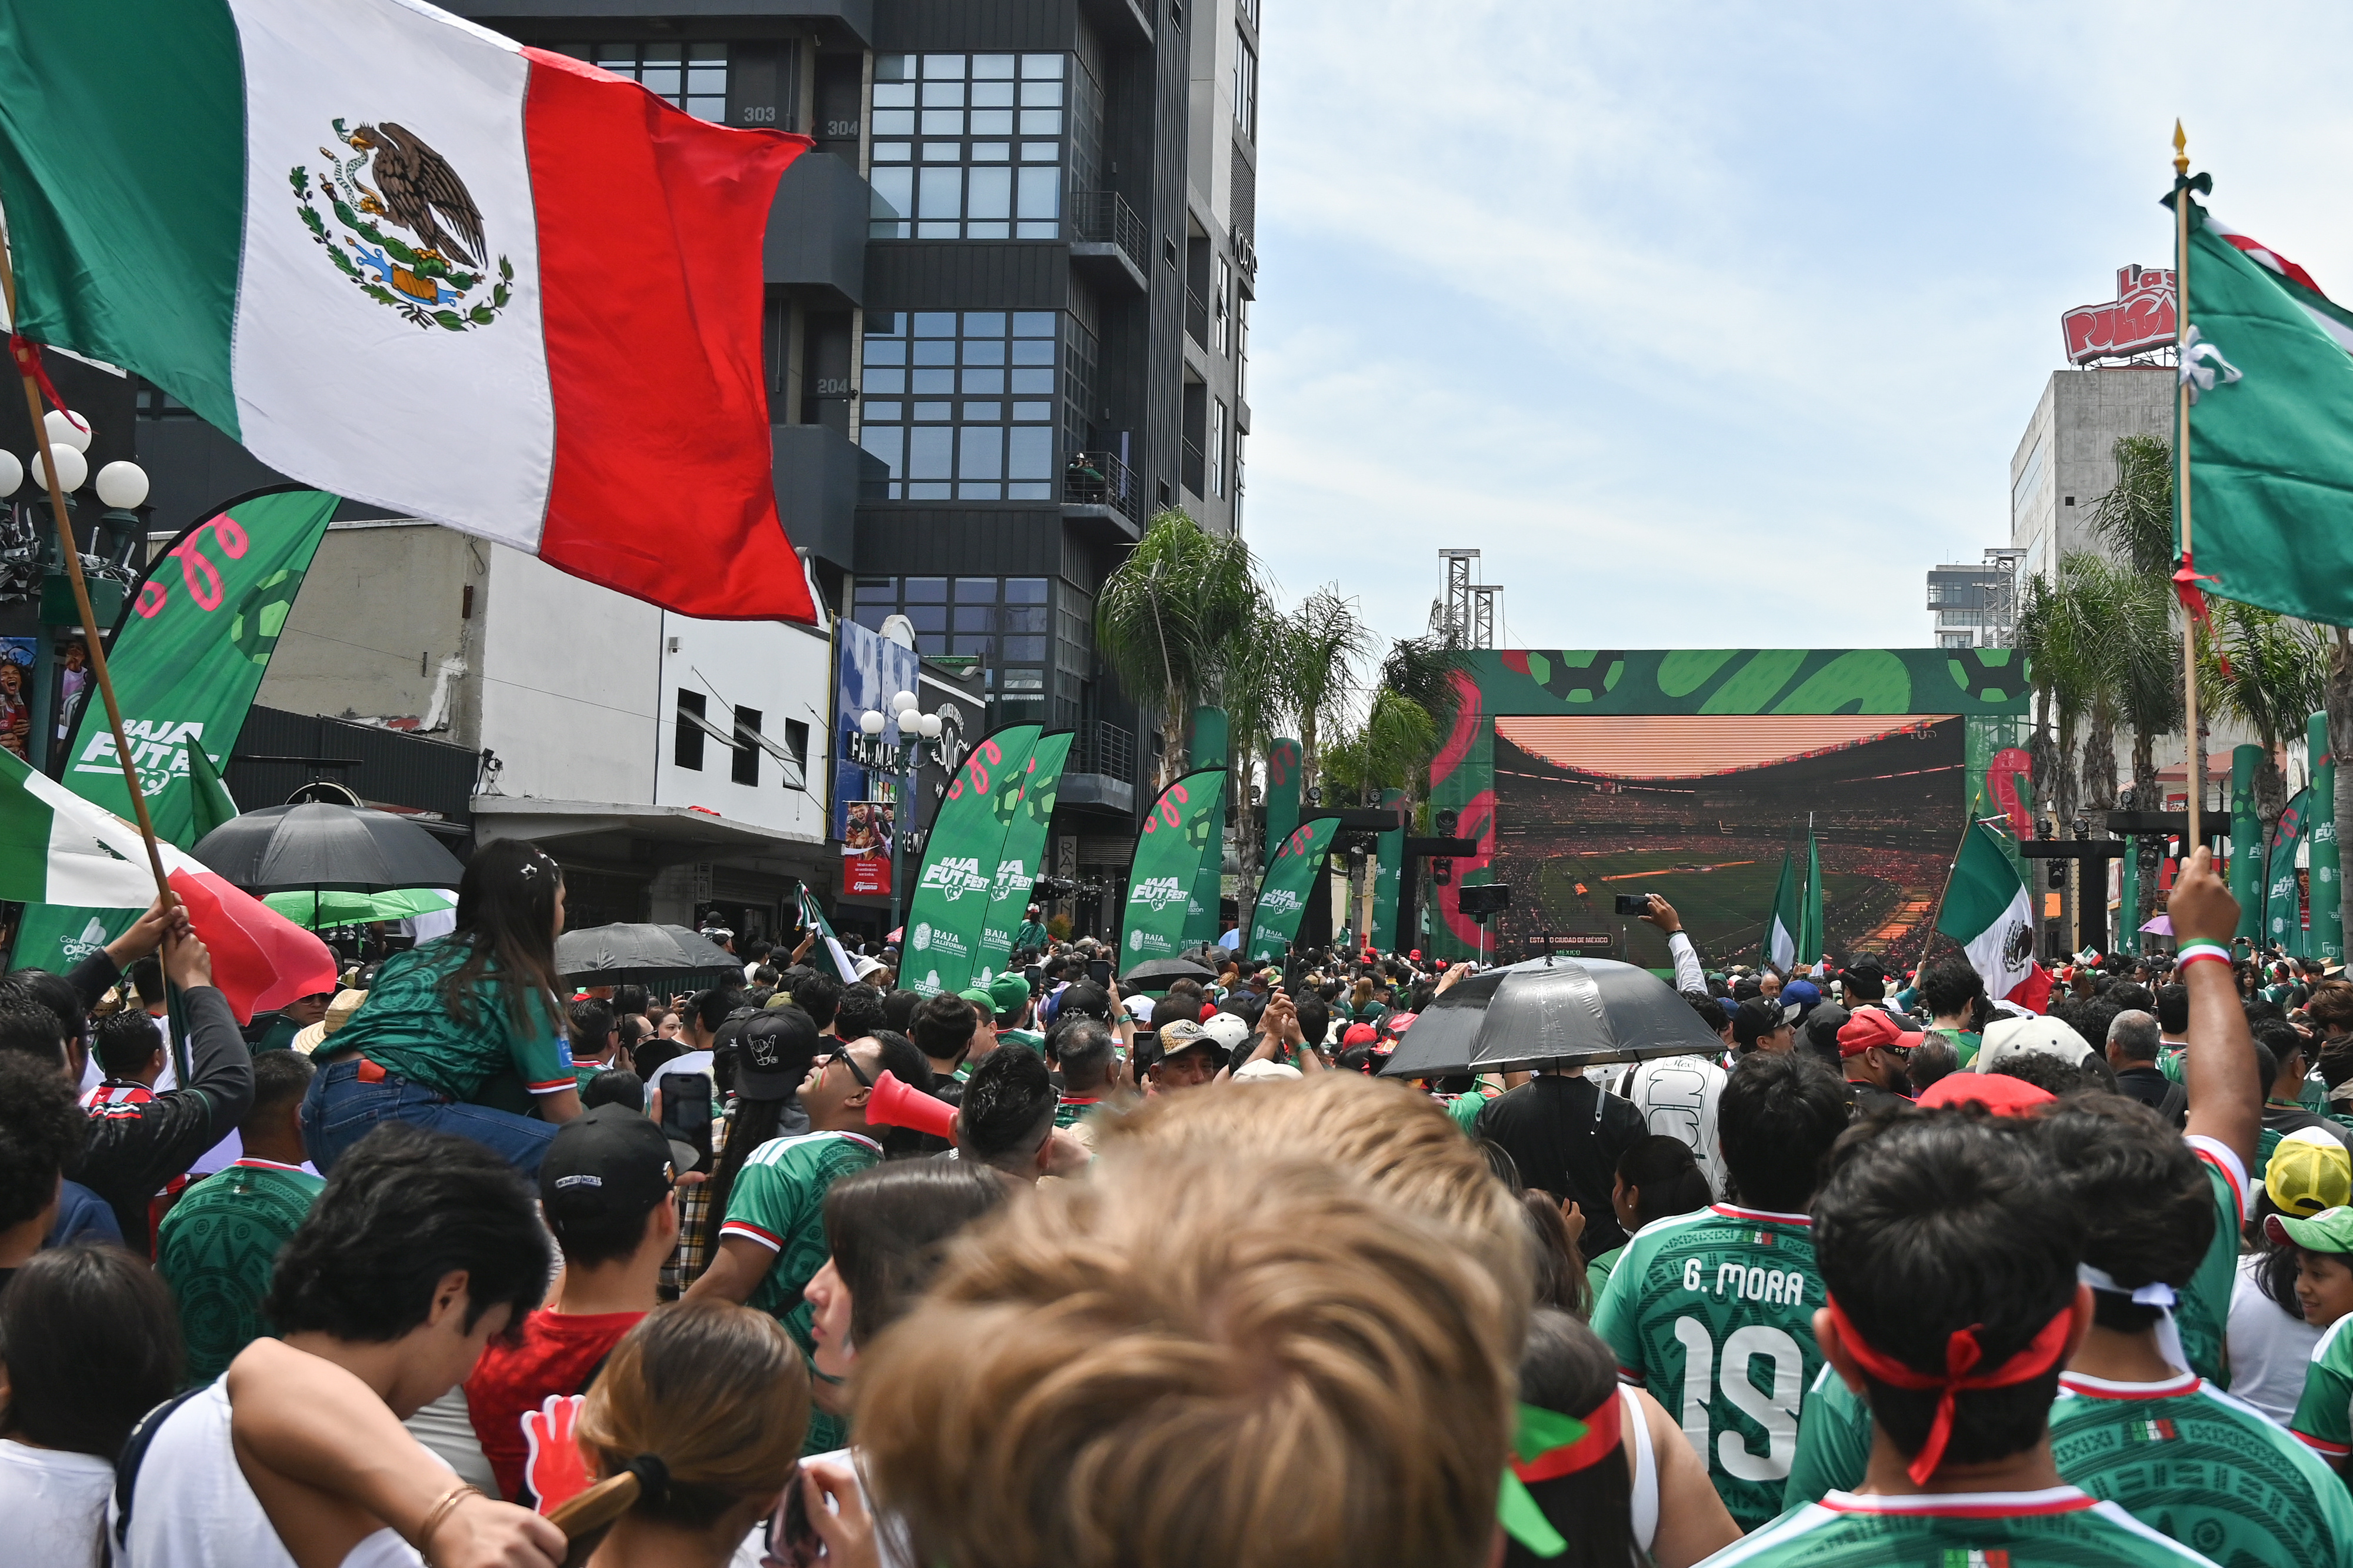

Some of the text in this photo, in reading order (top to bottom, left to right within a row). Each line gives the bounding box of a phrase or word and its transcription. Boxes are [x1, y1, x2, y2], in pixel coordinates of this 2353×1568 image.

[744, 106, 776, 122] 303
[828, 121, 859, 135] 304
[2120, 268, 2175, 298] Las
[2065, 294, 2175, 354] PULGA
[817, 378, 848, 393] 204
[122, 719, 204, 745] BAJA
[941, 857, 978, 875] BAJA
[997, 859, 1024, 875] JA
[923, 864, 965, 885] FUT
[962, 873, 990, 889] FEST
[1009, 874, 1033, 888] FEST
[1145, 877, 1178, 889] BAJA
[1131, 884, 1189, 900] FUT FEST
[1272, 889, 1296, 900] BAJA
[1261, 892, 1303, 908] FUT FEST
[933, 929, 959, 943] BAJA
[984, 928, 1008, 940] BAJA
[1145, 933, 1164, 942] BAJA
[1266, 928, 1282, 937] BAJA
[932, 938, 967, 951] CALIFORNIA
[914, 983, 945, 995] corazón
[1684, 1258, 1804, 1306] G. MORA
[1674, 1315, 1803, 1481] 19
